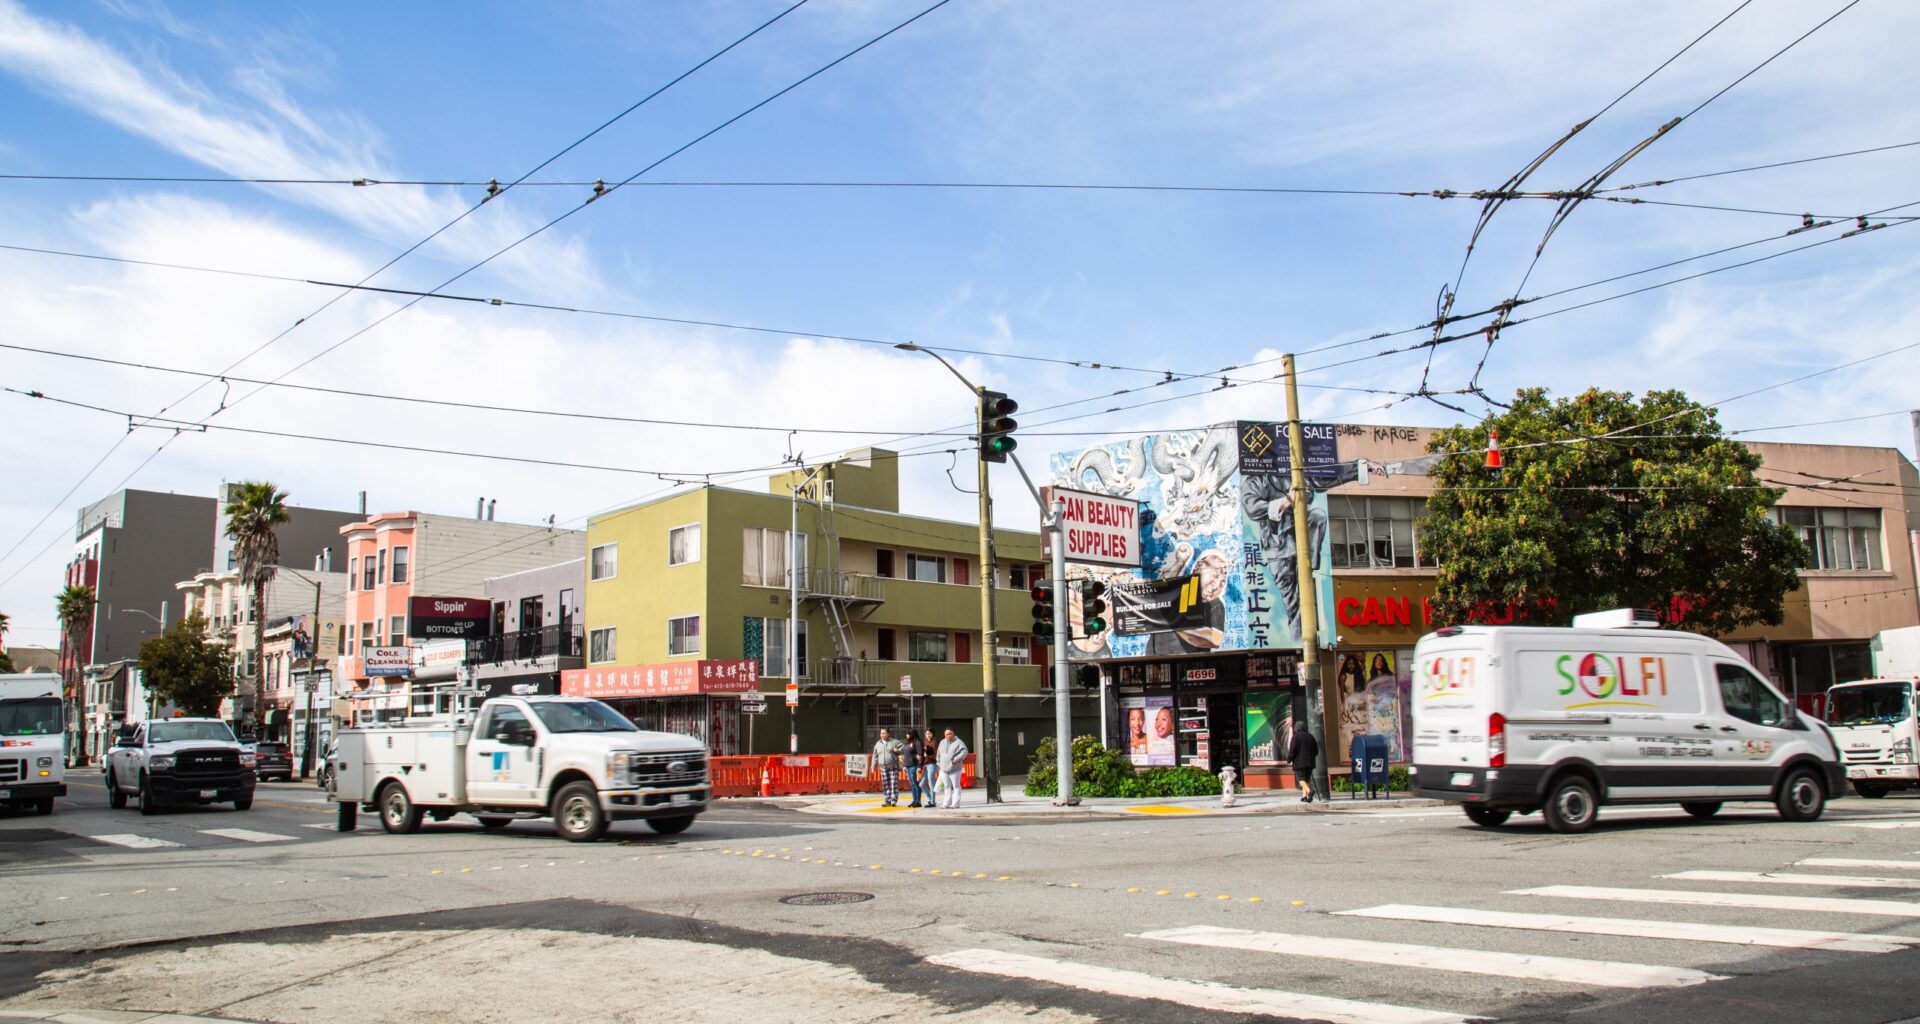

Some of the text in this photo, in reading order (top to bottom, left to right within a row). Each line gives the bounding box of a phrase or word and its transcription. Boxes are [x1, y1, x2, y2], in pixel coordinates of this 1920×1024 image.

[1304, 426, 1334, 440] SALE
[1087, 500, 1134, 529] BEAUTY
[1068, 528, 1127, 559] SUPPLIES
[434, 600, 468, 614] Sippin'
[1115, 600, 1172, 613] BUILDING FOR SALE
[1337, 596, 1411, 626] CAN
[376, 649, 399, 657] COLE
[1004, 648, 1021, 656] Persia
[367, 658, 409, 667] CLEANERS
[674, 667, 692, 676] PAIN
[1188, 669, 1215, 680] 4696
[1423, 657, 1476, 691] SOLFI
[1555, 652, 1668, 700] SOLFI
[306, 683, 318, 691] 20
[847, 761, 866, 770] DETOUR
